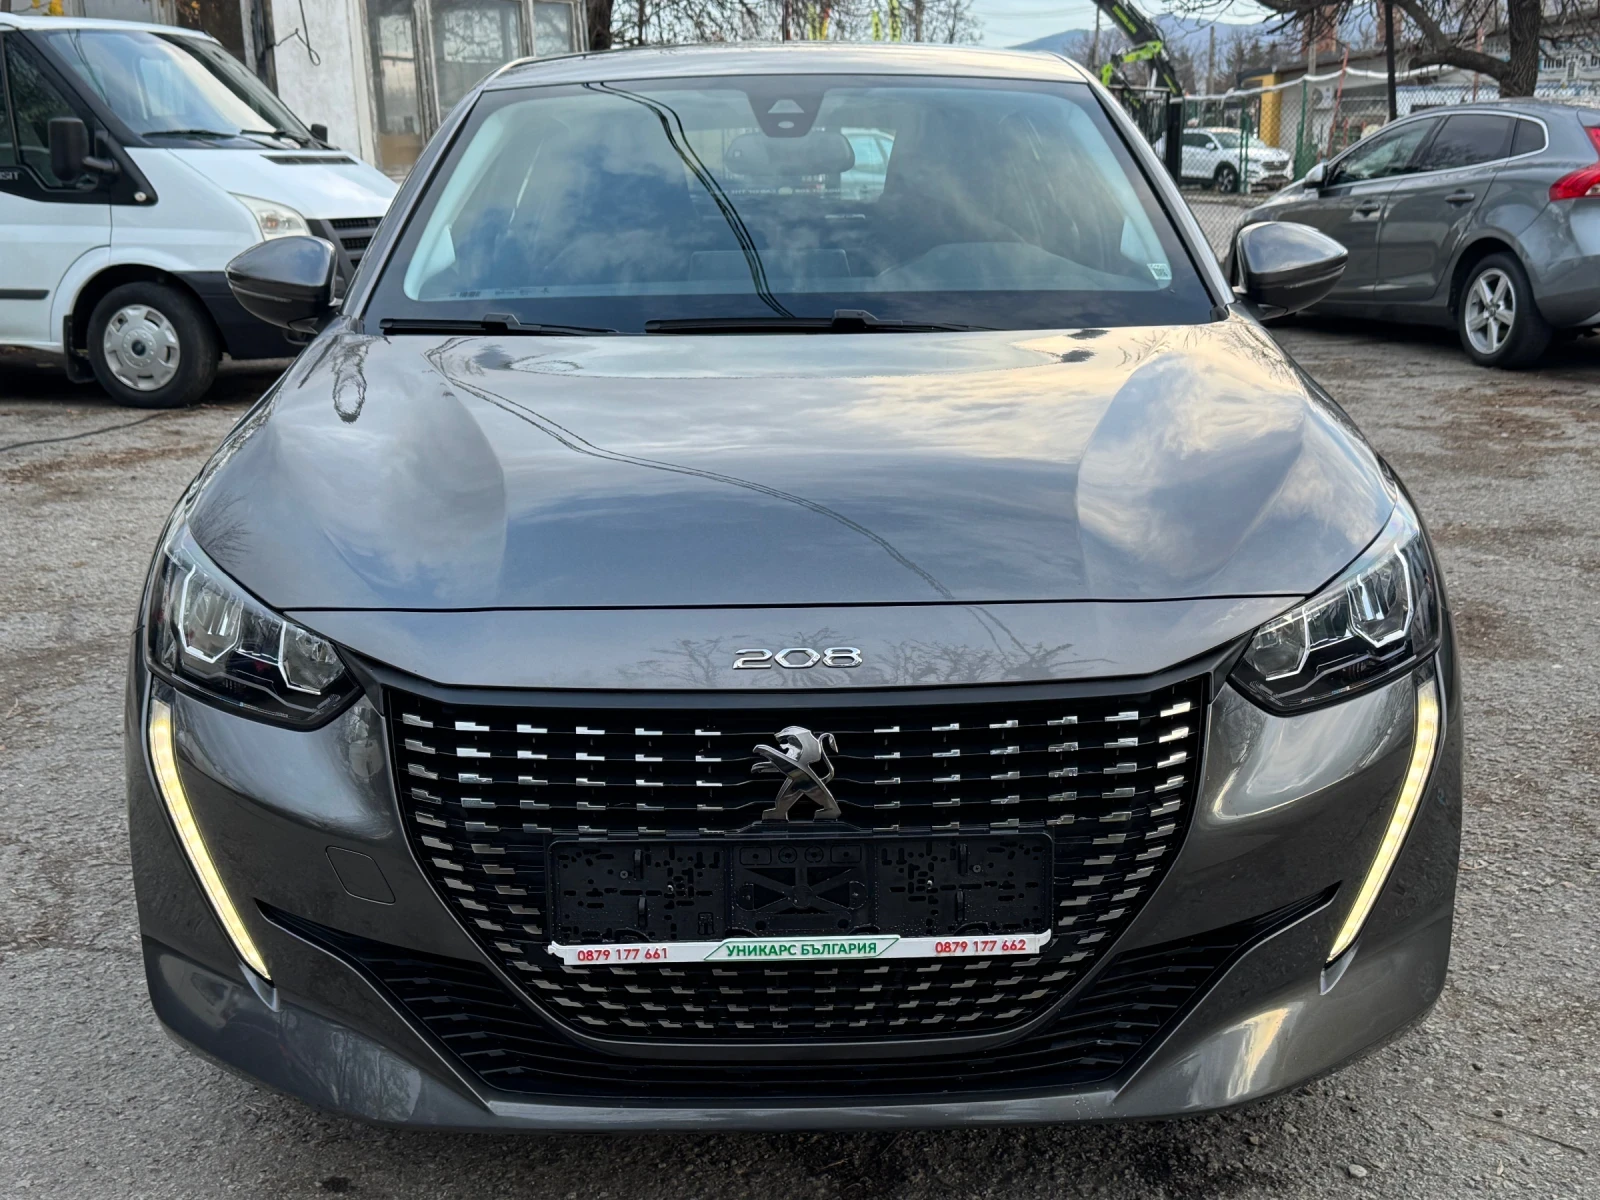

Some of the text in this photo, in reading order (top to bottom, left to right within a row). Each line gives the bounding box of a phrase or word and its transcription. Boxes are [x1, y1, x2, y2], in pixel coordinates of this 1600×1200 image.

[0, 171, 18, 180] SIT
[733, 647, 862, 669] 208
[577, 947, 668, 961] 0879 177 661
[726, 942, 877, 957] УНИКАРС БЪЛГАРИЯ
[935, 939, 1026, 954] 0879 177 662
